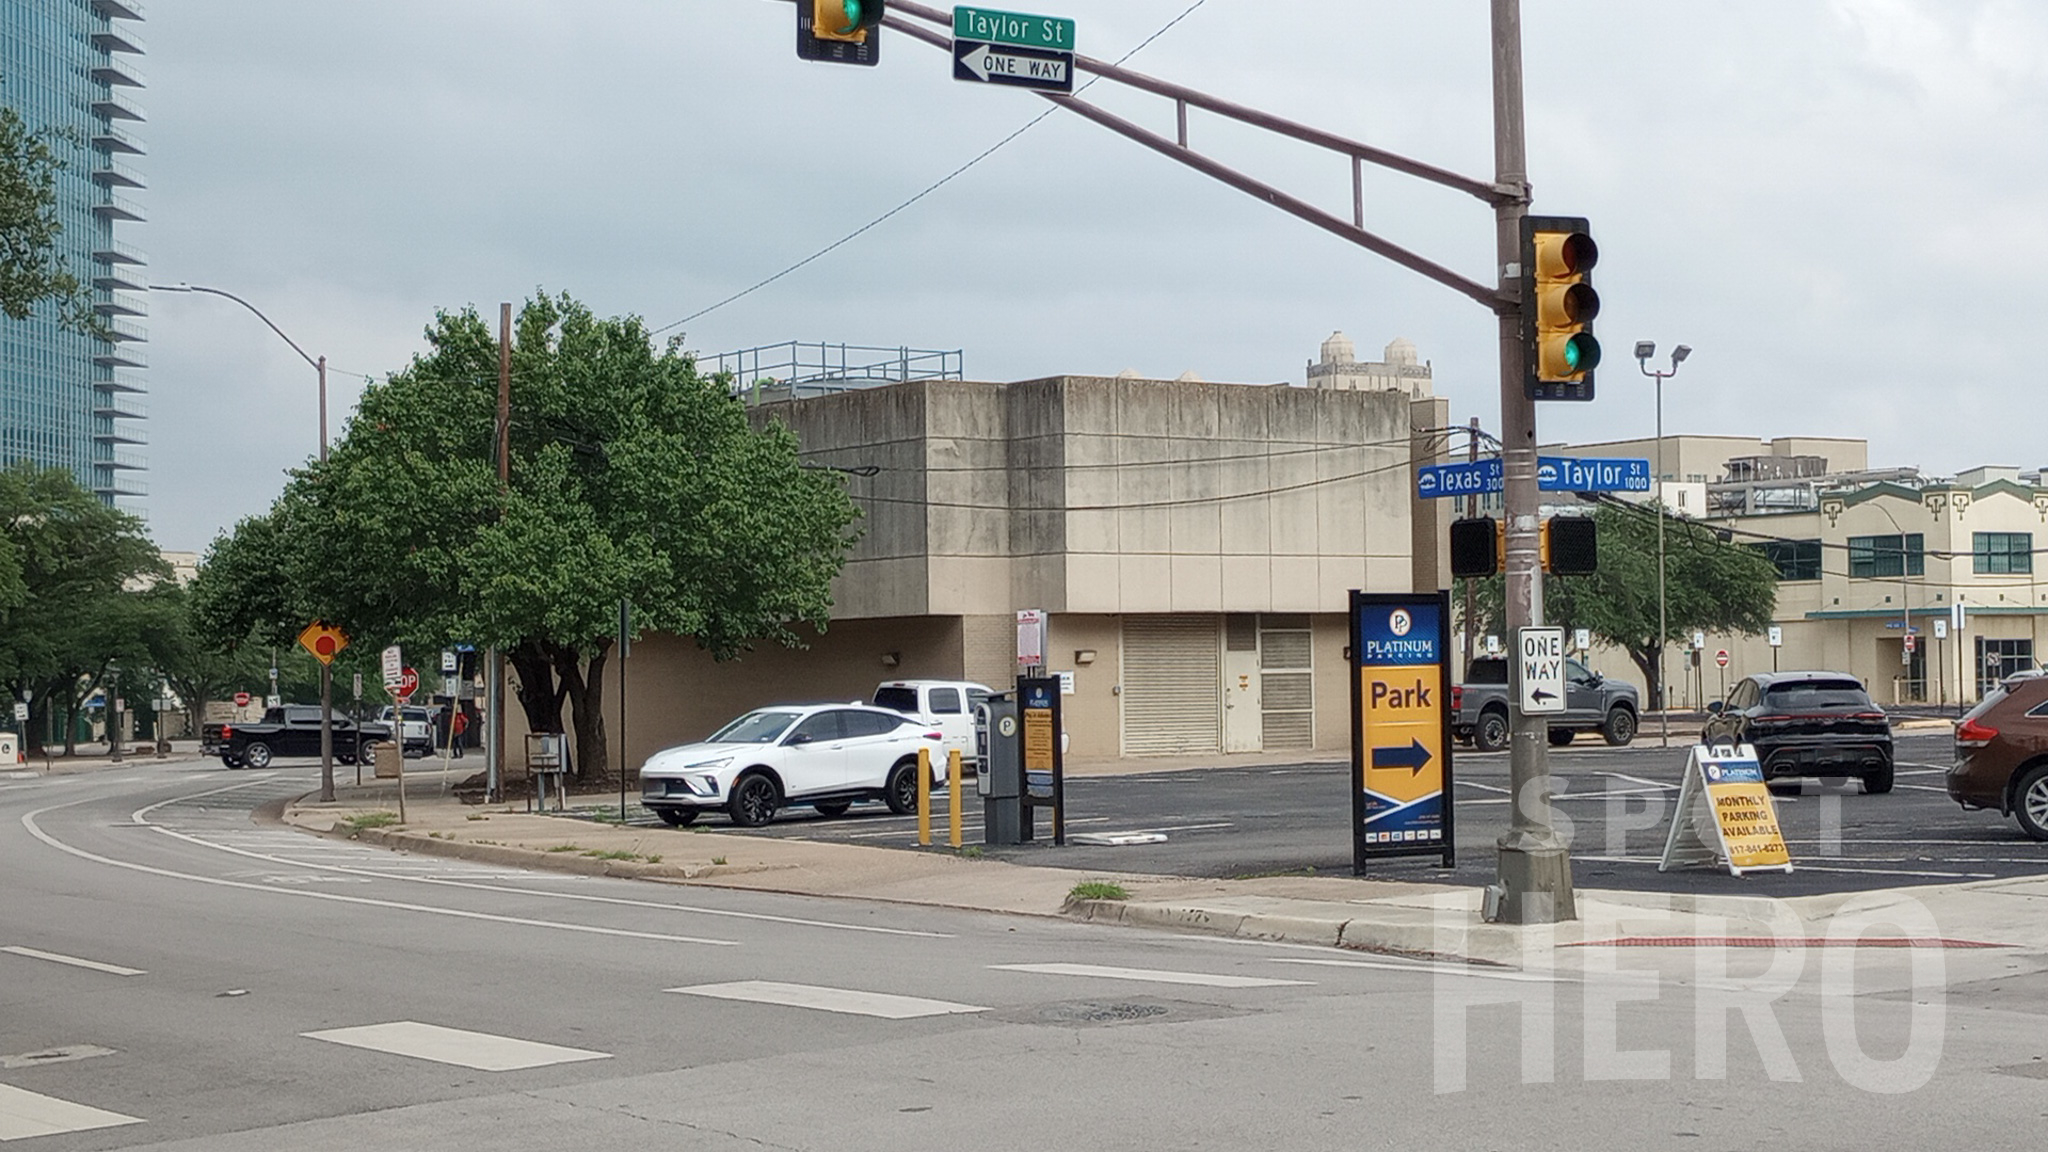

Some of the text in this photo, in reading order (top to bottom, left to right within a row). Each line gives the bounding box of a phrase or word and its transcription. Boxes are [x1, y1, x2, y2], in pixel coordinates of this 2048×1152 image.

[967, 11, 1063, 43] Taylor St
[984, 55, 1063, 79] ONE WAY
[1438, 463, 1500, 491] Texas St
[1486, 477, 1503, 491] 300
[1562, 460, 1641, 491] Taylor St
[1625, 476, 1647, 490] 1000
[1367, 640, 1433, 654] PLATINUM
[1524, 637, 1560, 658] ONE
[1525, 660, 1561, 681] WAY
[1371, 679, 1431, 709] Park
[1716, 795, 1765, 807] MONTHLY
[1722, 810, 1768, 822] PARKING
[1723, 825, 1778, 837] AVAILABLE
